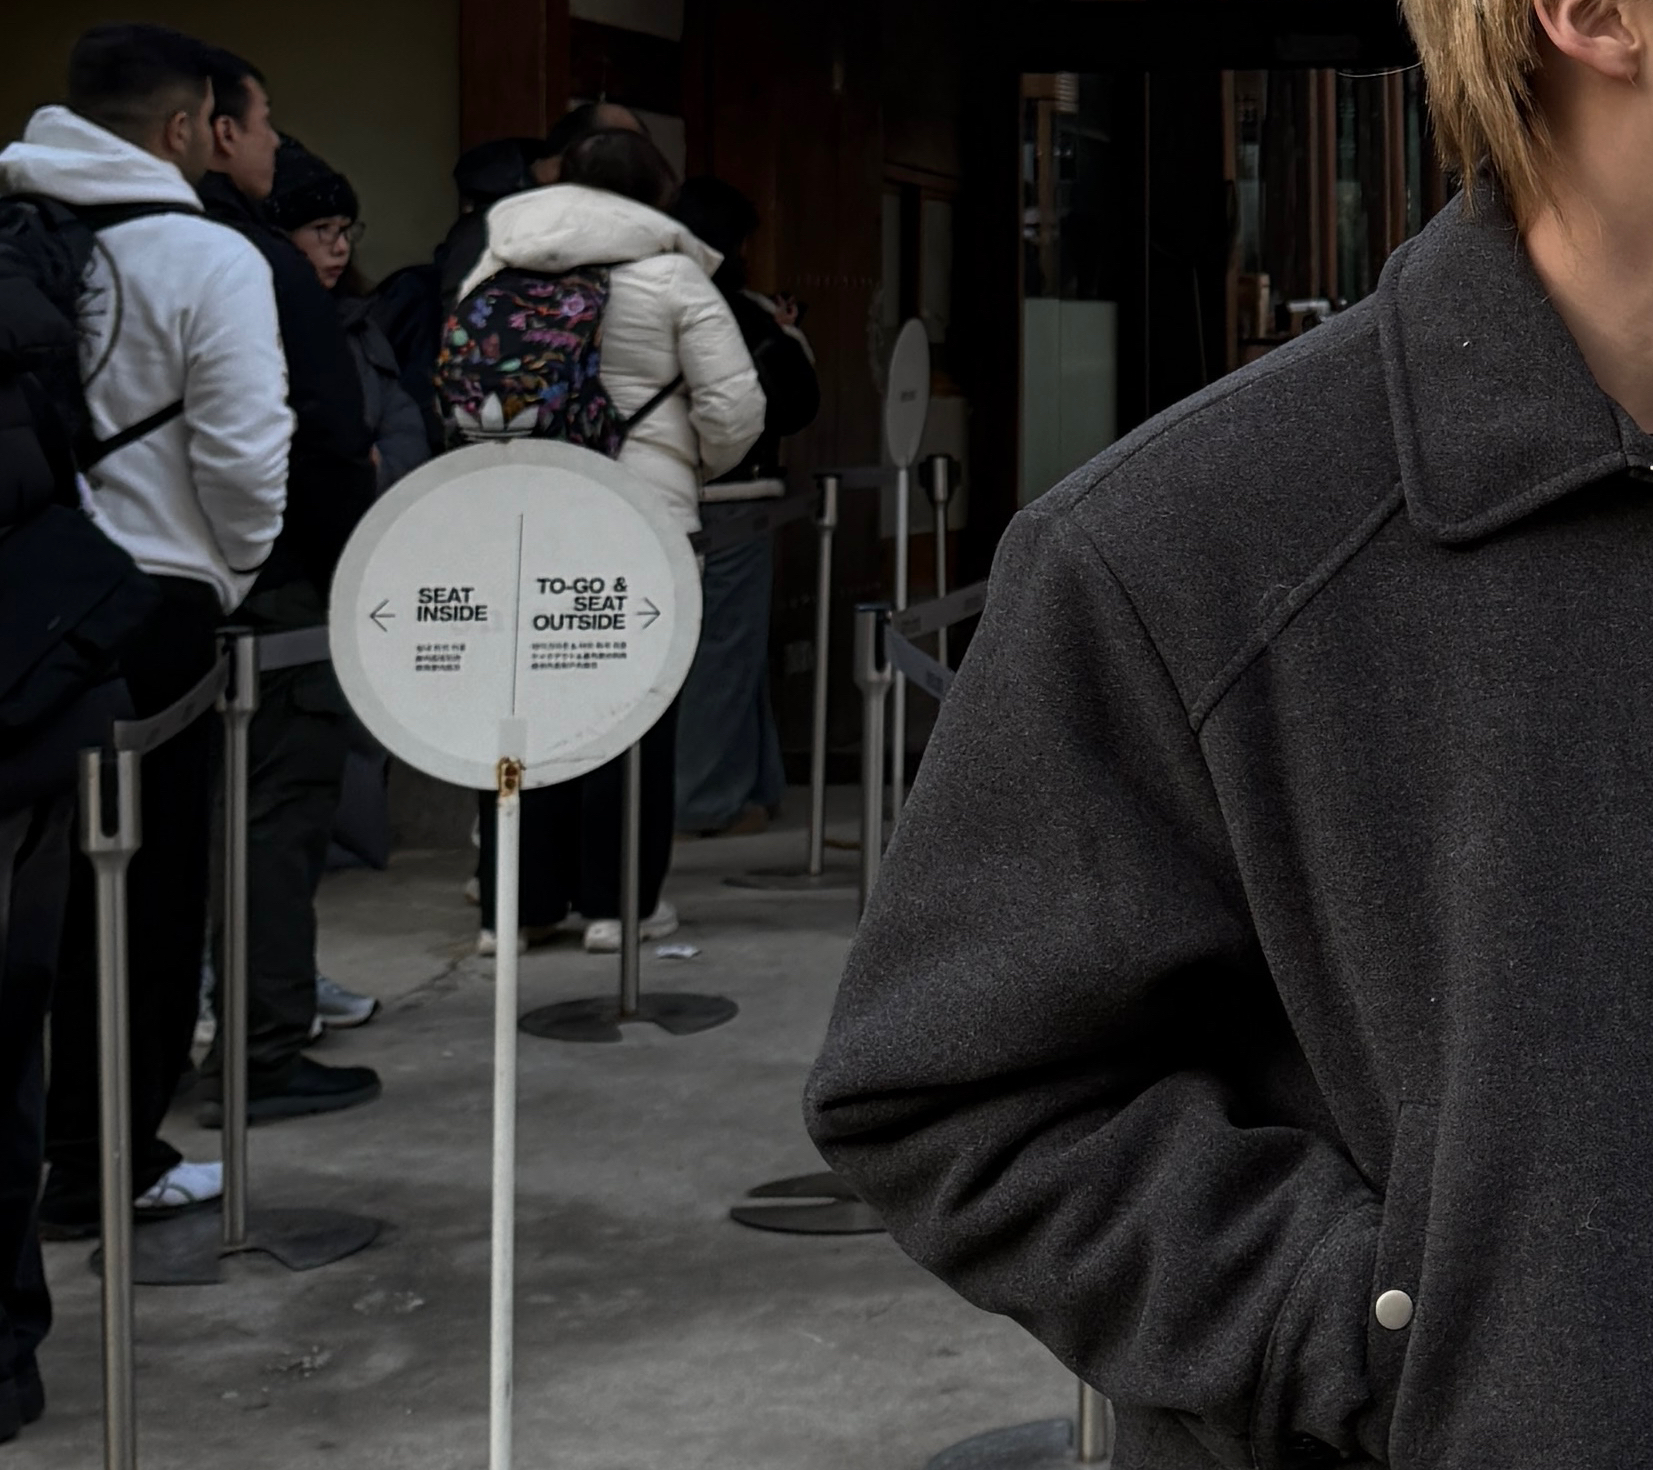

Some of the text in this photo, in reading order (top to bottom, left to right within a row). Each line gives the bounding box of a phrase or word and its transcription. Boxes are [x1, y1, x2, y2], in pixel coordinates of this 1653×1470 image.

[537, 577, 628, 594] TO-GO &
[418, 587, 475, 604] SEAT
[574, 596, 628, 612] SEAT
[417, 605, 488, 622] INSIDE
[533, 614, 626, 631] OUTSIDE
